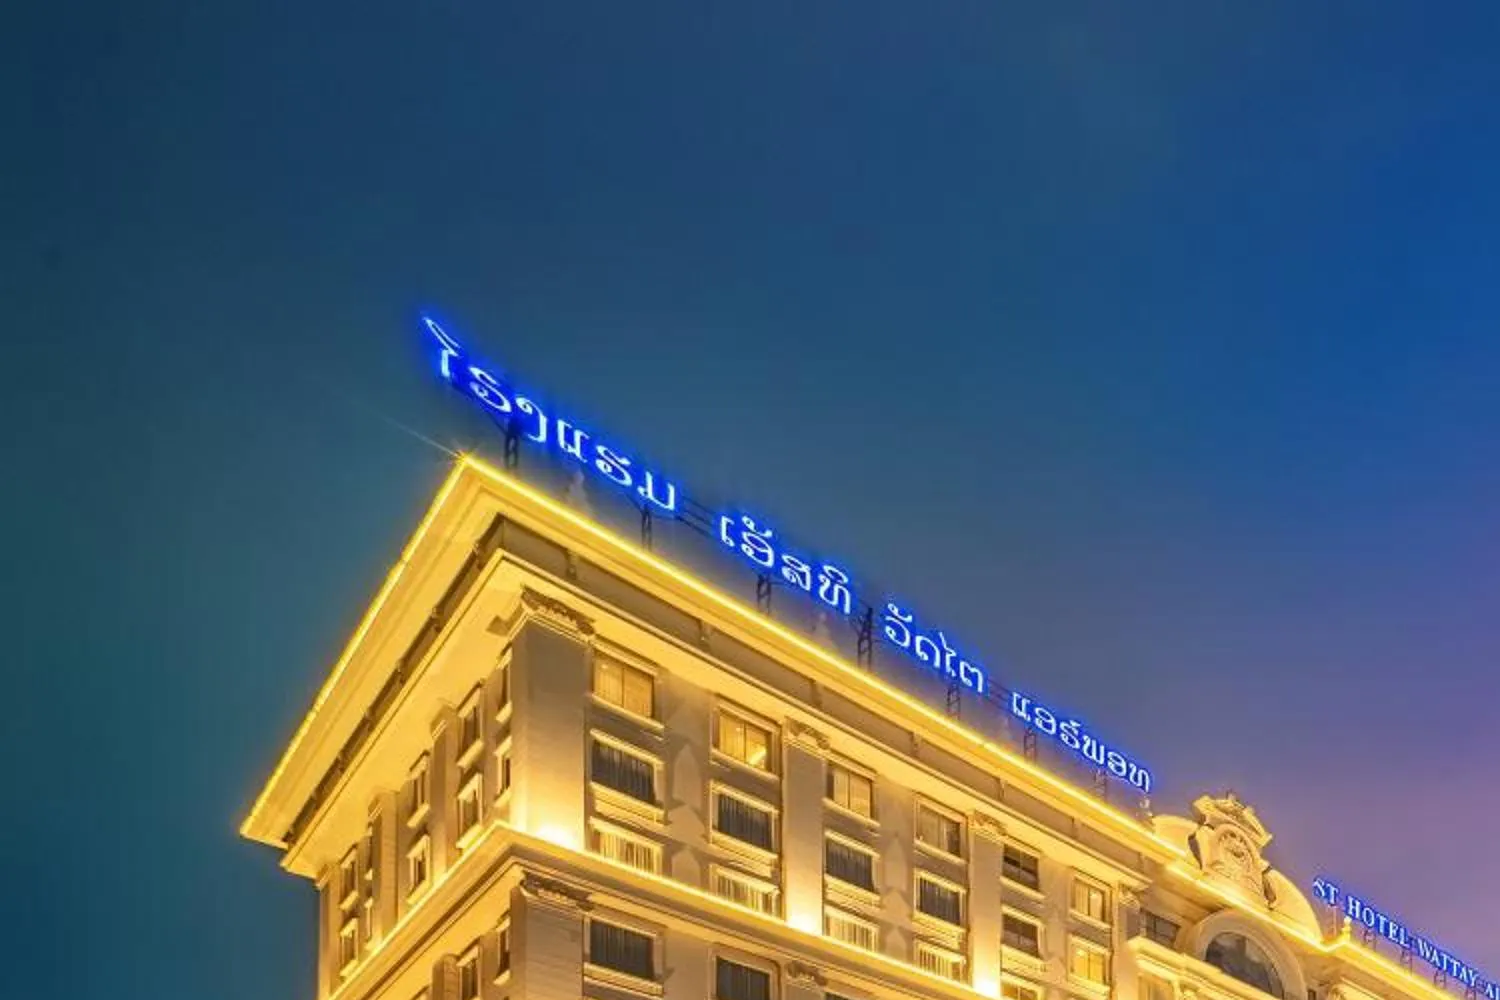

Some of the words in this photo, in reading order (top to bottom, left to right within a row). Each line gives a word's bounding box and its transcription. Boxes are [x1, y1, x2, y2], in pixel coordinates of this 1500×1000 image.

[1312, 876, 1339, 906] ST
[1346, 895, 1411, 948] HOTEL
[1417, 938, 1479, 988] WATTAY
